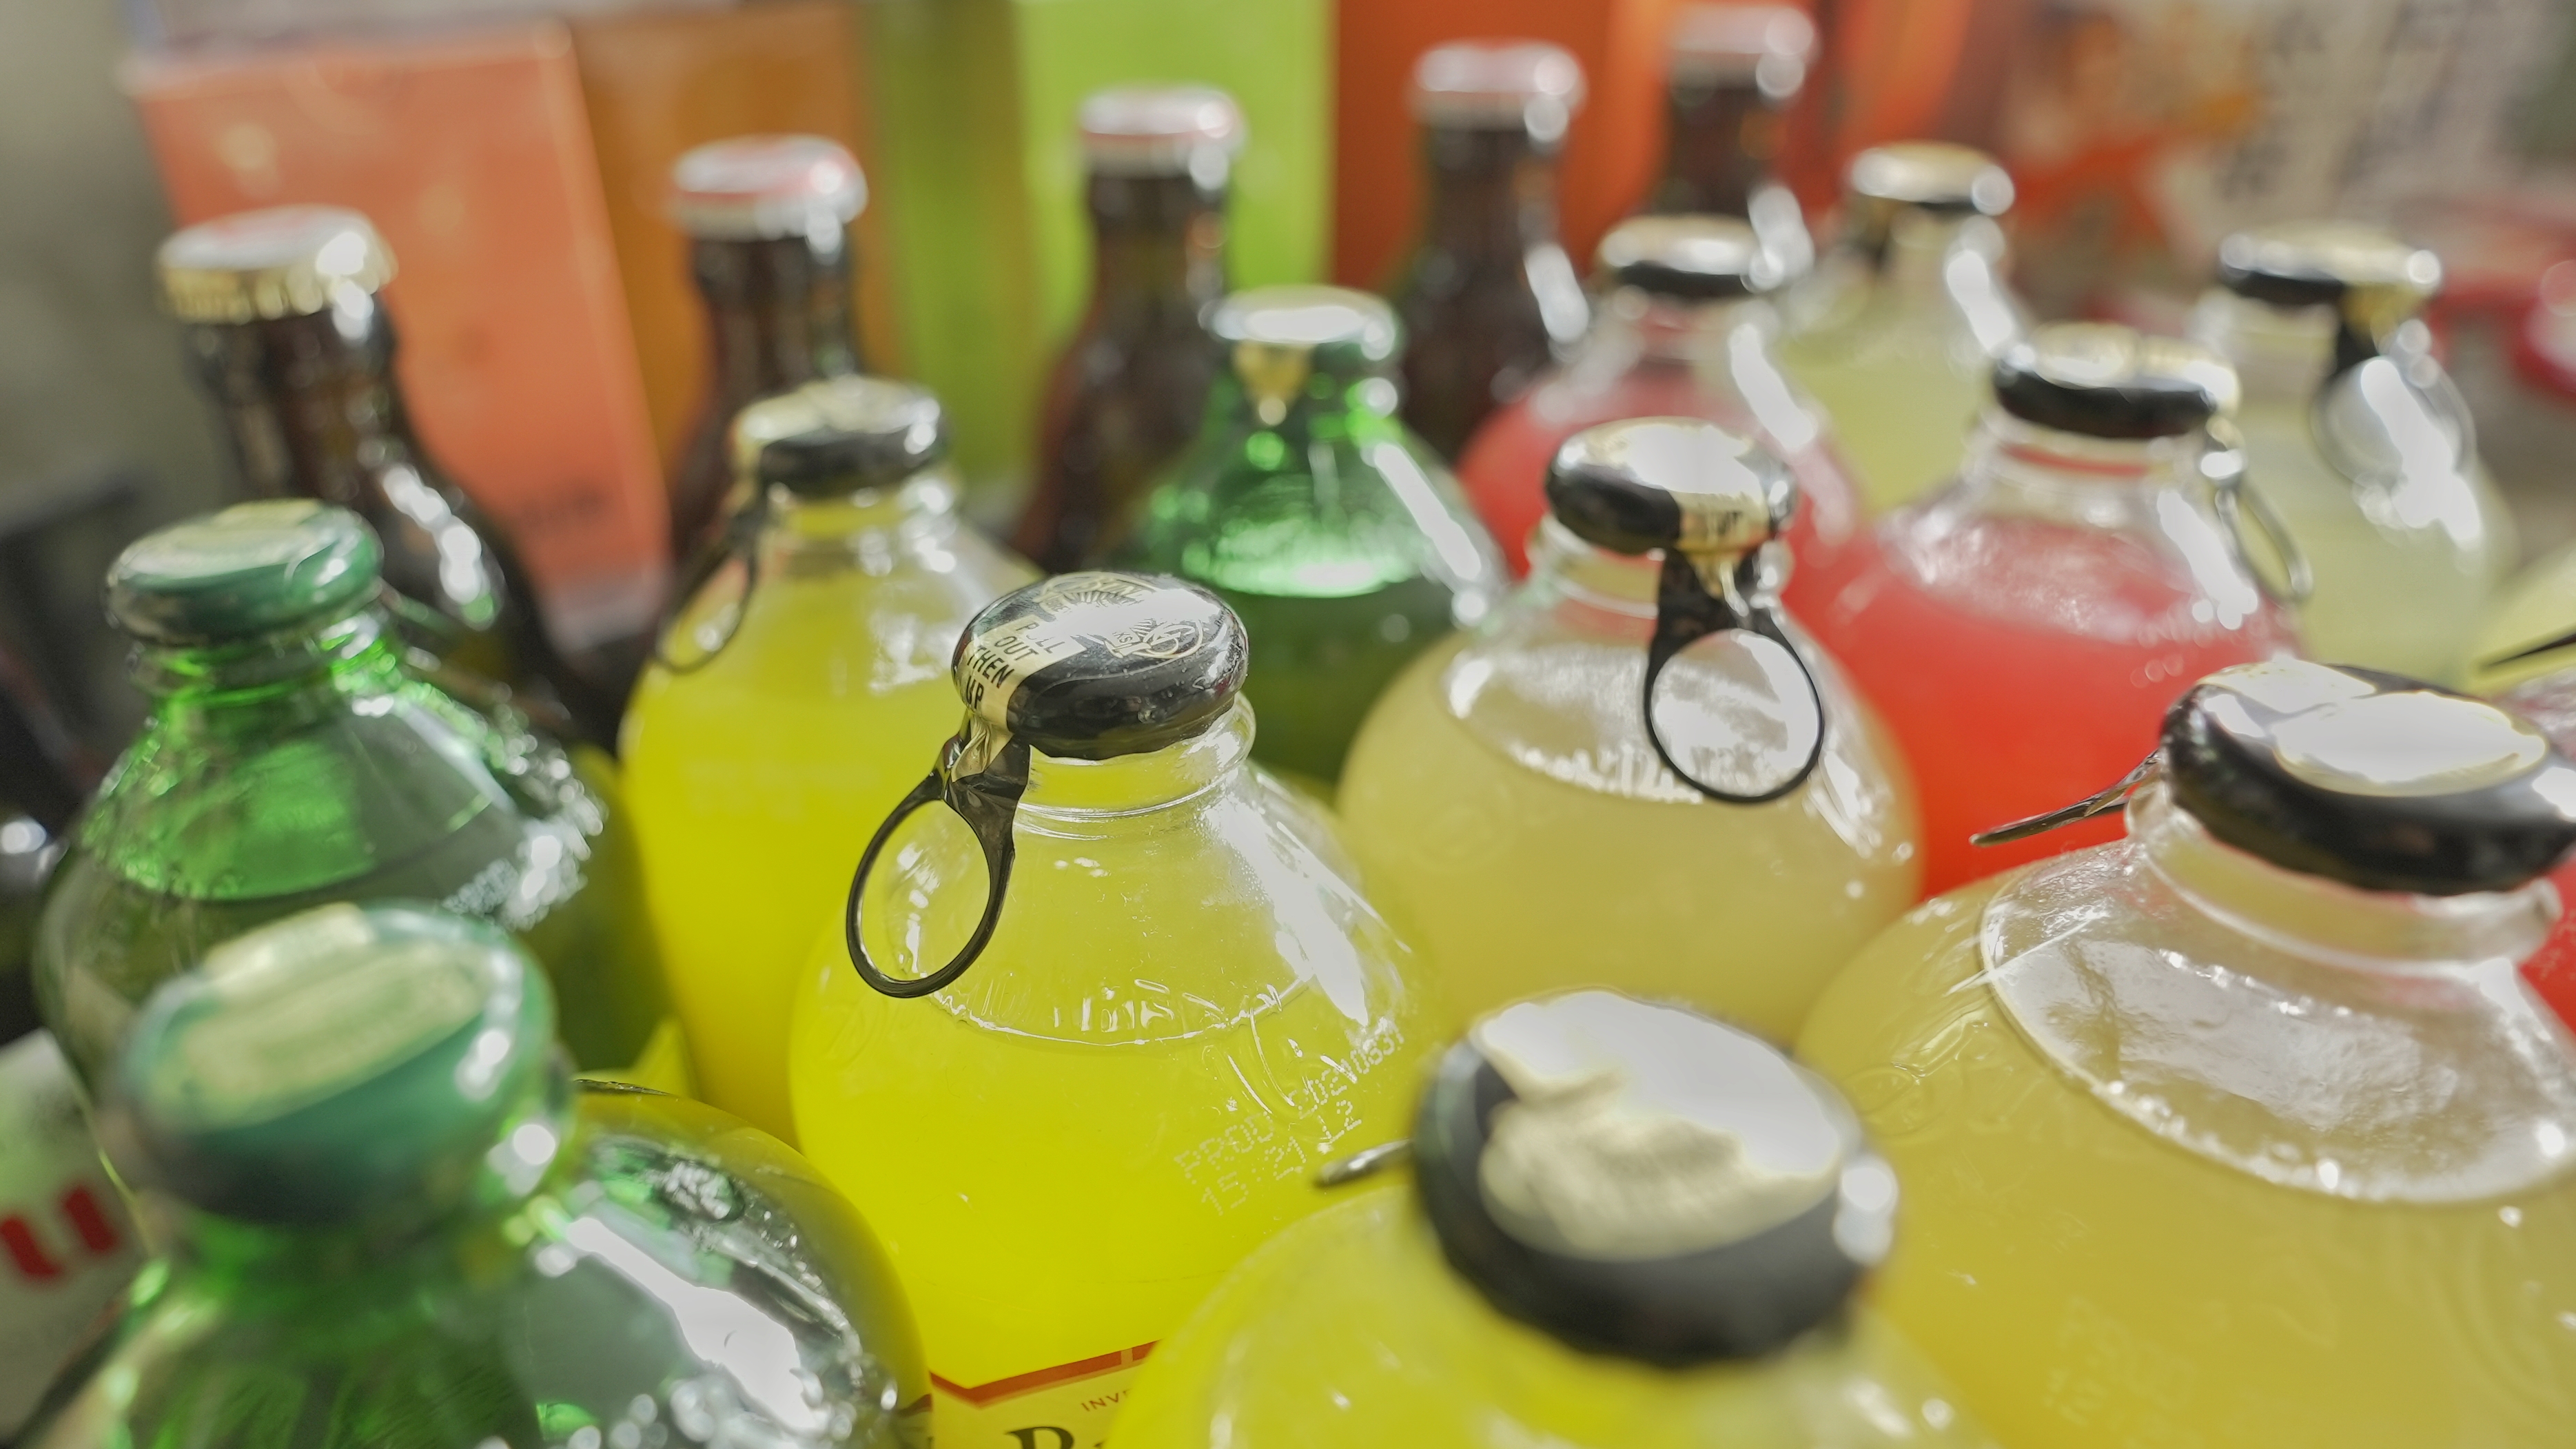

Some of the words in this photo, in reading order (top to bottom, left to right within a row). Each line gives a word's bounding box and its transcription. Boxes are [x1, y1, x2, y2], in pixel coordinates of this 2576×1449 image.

[994, 635, 1039, 662] OUT
[1016, 621, 1065, 655] PLL
[966, 645, 1016, 690] THEN
[966, 677, 985, 710] UP
[1174, 1111, 1274, 1185] PROD
[1201, 1135, 1307, 1217] 15:21
[1081, 1388, 1132, 1412] INV
